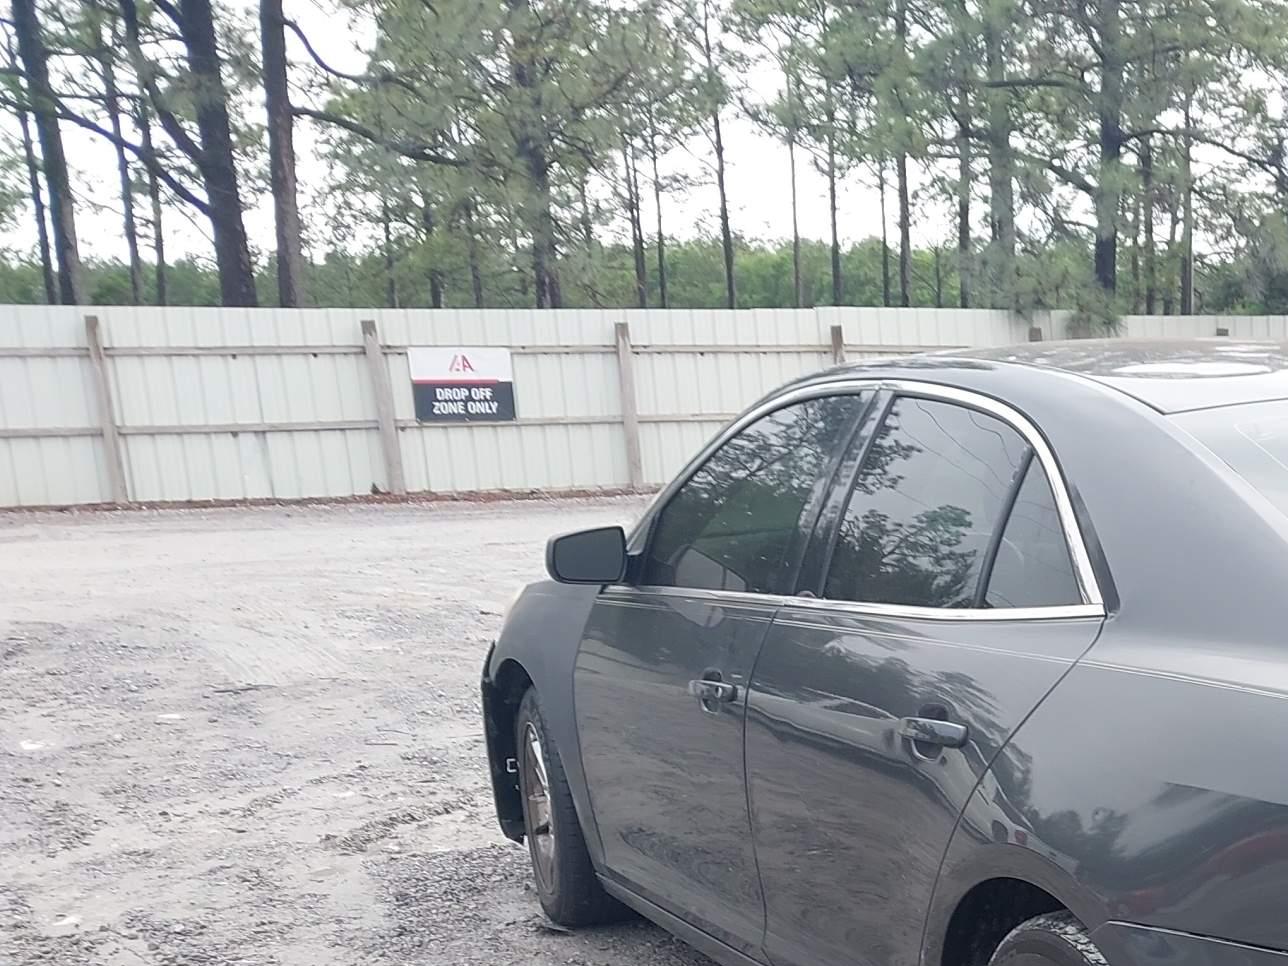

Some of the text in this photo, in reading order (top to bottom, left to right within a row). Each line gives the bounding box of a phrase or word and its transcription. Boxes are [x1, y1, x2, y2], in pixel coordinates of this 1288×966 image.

[435, 388, 493, 400] DROP OFF
[432, 401, 498, 414] ZONE ONLY
